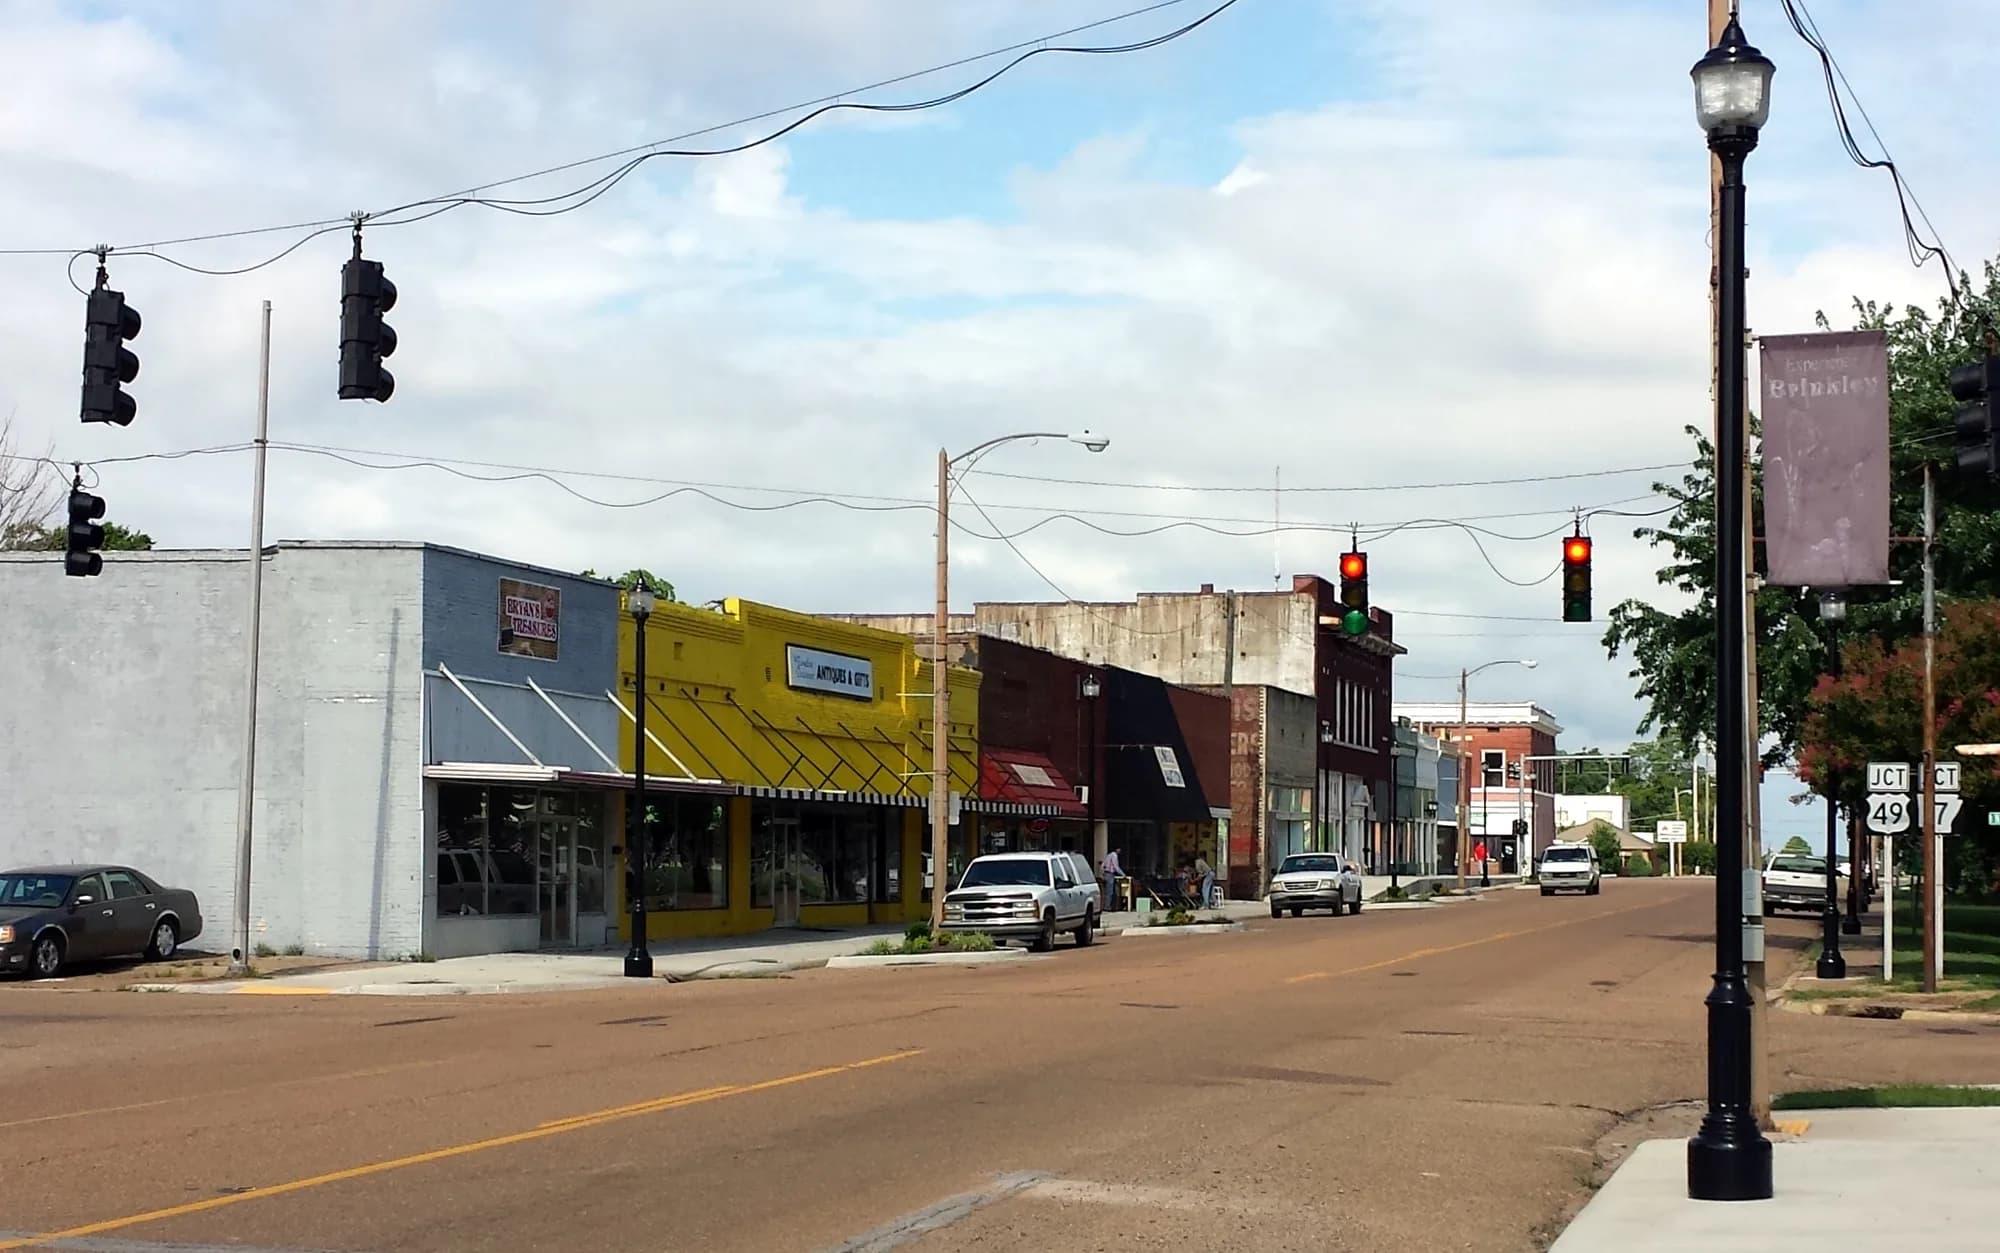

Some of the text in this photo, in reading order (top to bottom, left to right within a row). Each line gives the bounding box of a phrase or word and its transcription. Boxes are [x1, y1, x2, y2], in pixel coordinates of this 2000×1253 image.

[1769, 375, 1879, 398] Brinkley
[512, 617, 556, 639] TREASURES
[816, 665, 846, 684] ANTIQUES
[854, 672, 869, 688] GIFTS
[1871, 768, 1906, 786] JCT
[1931, 768, 1957, 786] CT
[1873, 802, 1903, 825] 49
